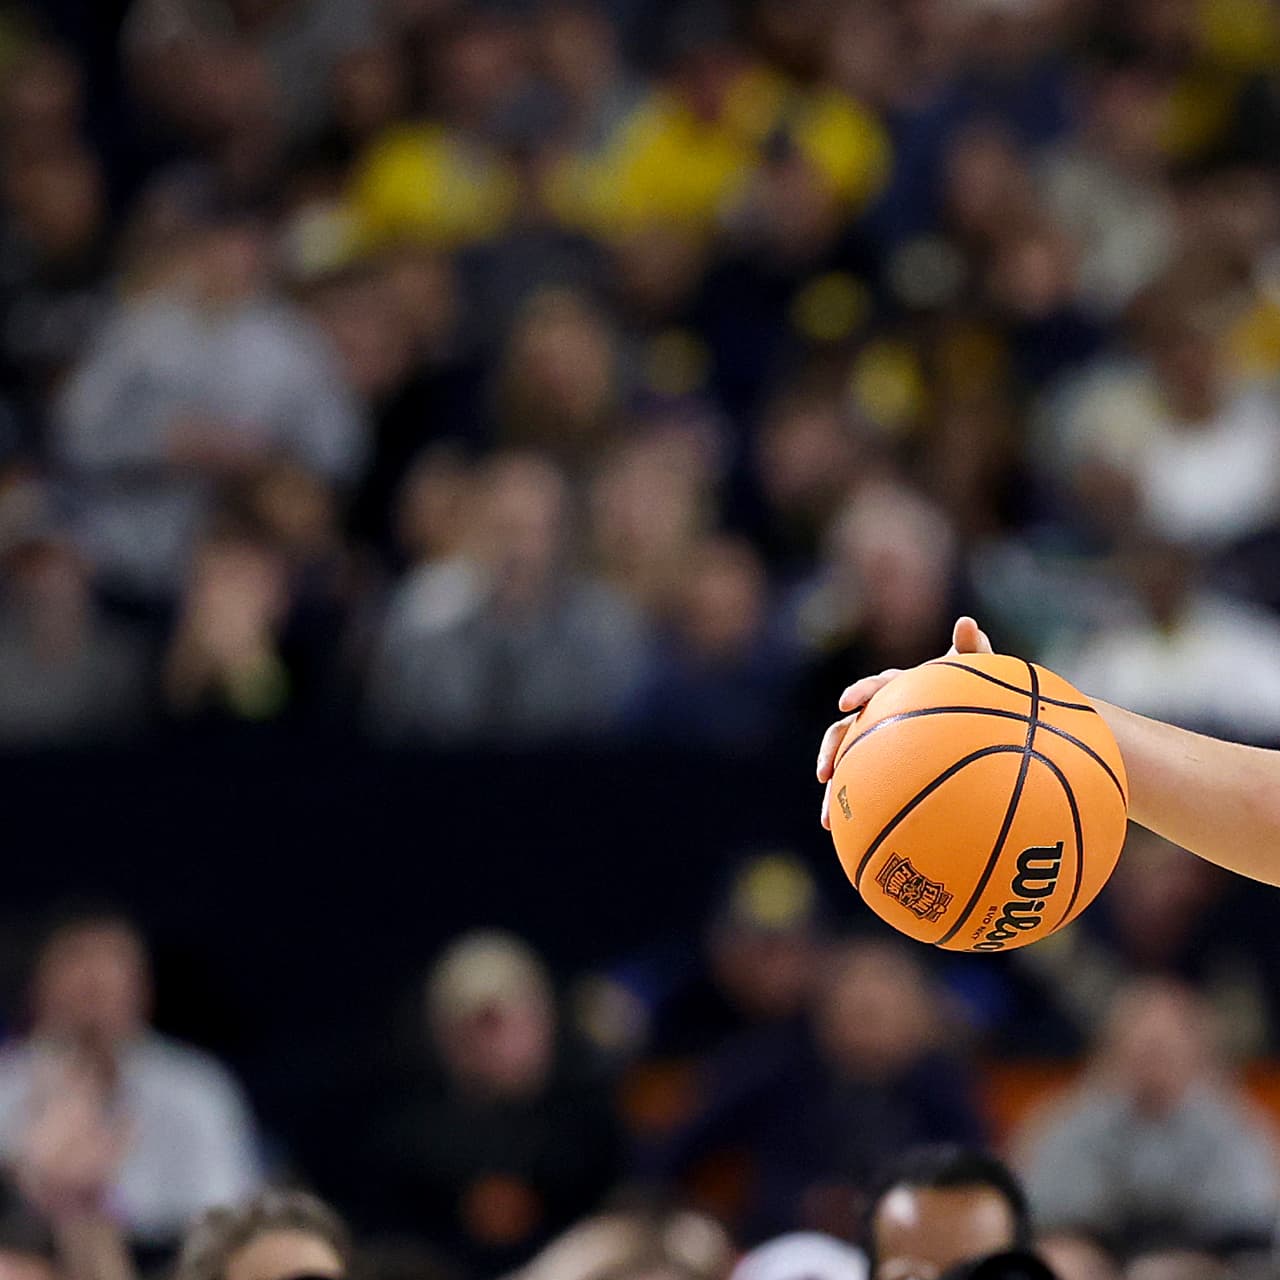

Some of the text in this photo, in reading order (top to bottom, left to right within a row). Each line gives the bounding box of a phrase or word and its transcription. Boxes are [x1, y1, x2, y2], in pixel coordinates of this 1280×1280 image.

[887, 866, 911, 895] FOUR
[911, 885, 938, 913] FINAL
[973, 841, 1064, 951] Wilso
